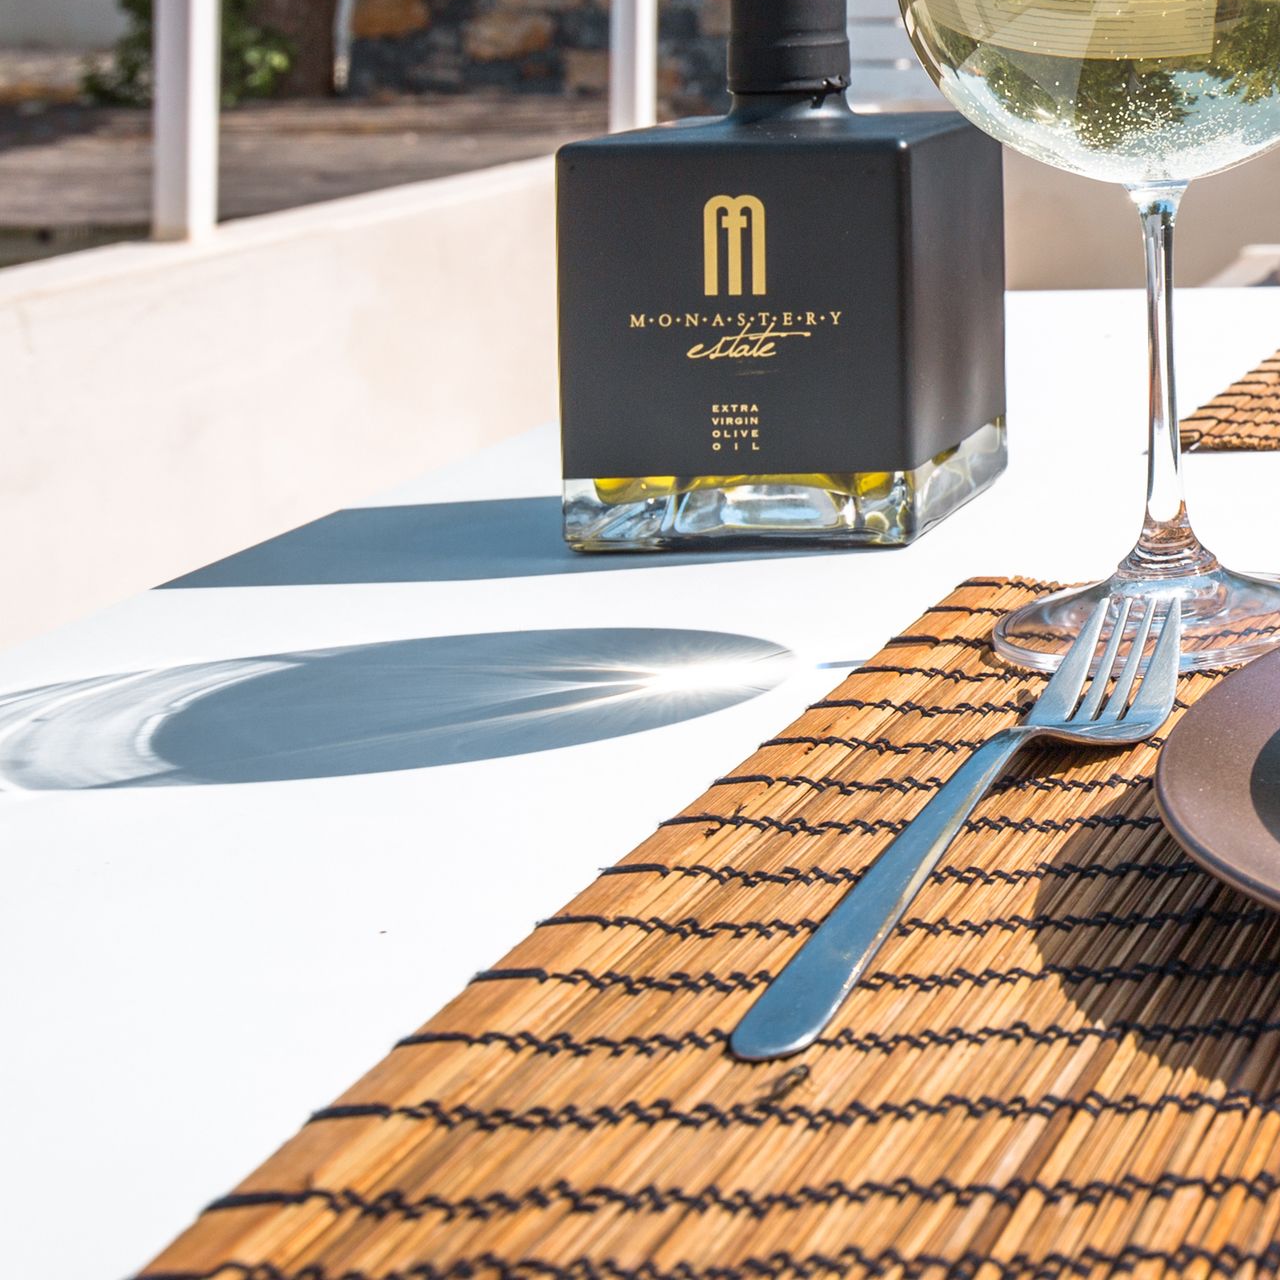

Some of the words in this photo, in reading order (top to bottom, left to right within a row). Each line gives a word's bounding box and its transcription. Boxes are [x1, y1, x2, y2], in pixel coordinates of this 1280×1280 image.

[686, 322, 812, 360] estate
[712, 404, 759, 413] EXTRA
[711, 417, 759, 426] VIRGIN
[712, 429, 759, 438] OLIVE
